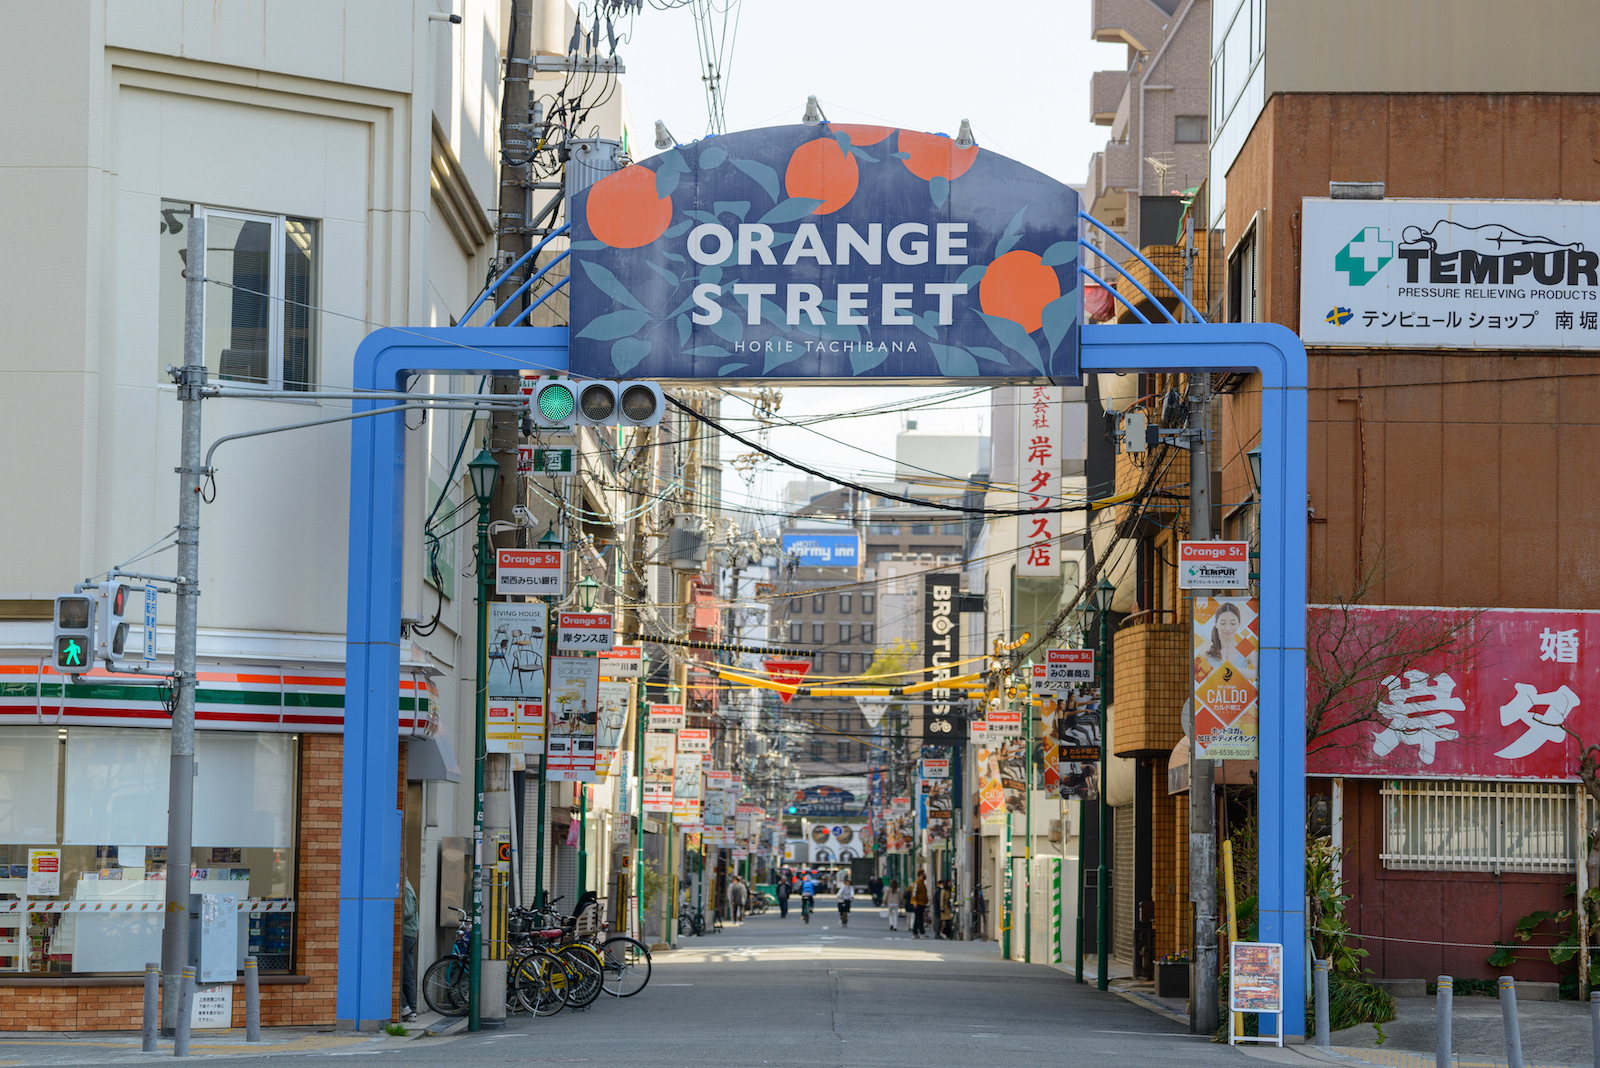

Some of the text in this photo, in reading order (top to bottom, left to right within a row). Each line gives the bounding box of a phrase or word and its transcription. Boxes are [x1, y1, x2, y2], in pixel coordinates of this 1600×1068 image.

[686, 222, 969, 267] ORANGE
[1398, 249, 1599, 286] TEMPUR
[1398, 287, 1597, 301] PRESSURE RELIEVING PRODUCTS
[691, 282, 969, 326] STREET
[734, 341, 918, 353] HORIE TACHIBANA
[1026, 435, 1052, 567] 岸タンス店
[1184, 546, 1243, 558] Orange St.
[501, 553, 558, 566] Orange St.
[1199, 568, 1236, 576] TEMPUR
[501, 575, 558, 585] 関西みらい銀行
[562, 616, 609, 626] Orange St.
[563, 633, 609, 644] 岸タンス店
[931, 585, 954, 715] BROTURES
[1539, 627, 1580, 663] 婚
[1050, 652, 1079, 661] Orange
[557, 665, 593, 676] salone
[1206, 689, 1247, 704] CALDO
[989, 713, 1010, 721] Orange
